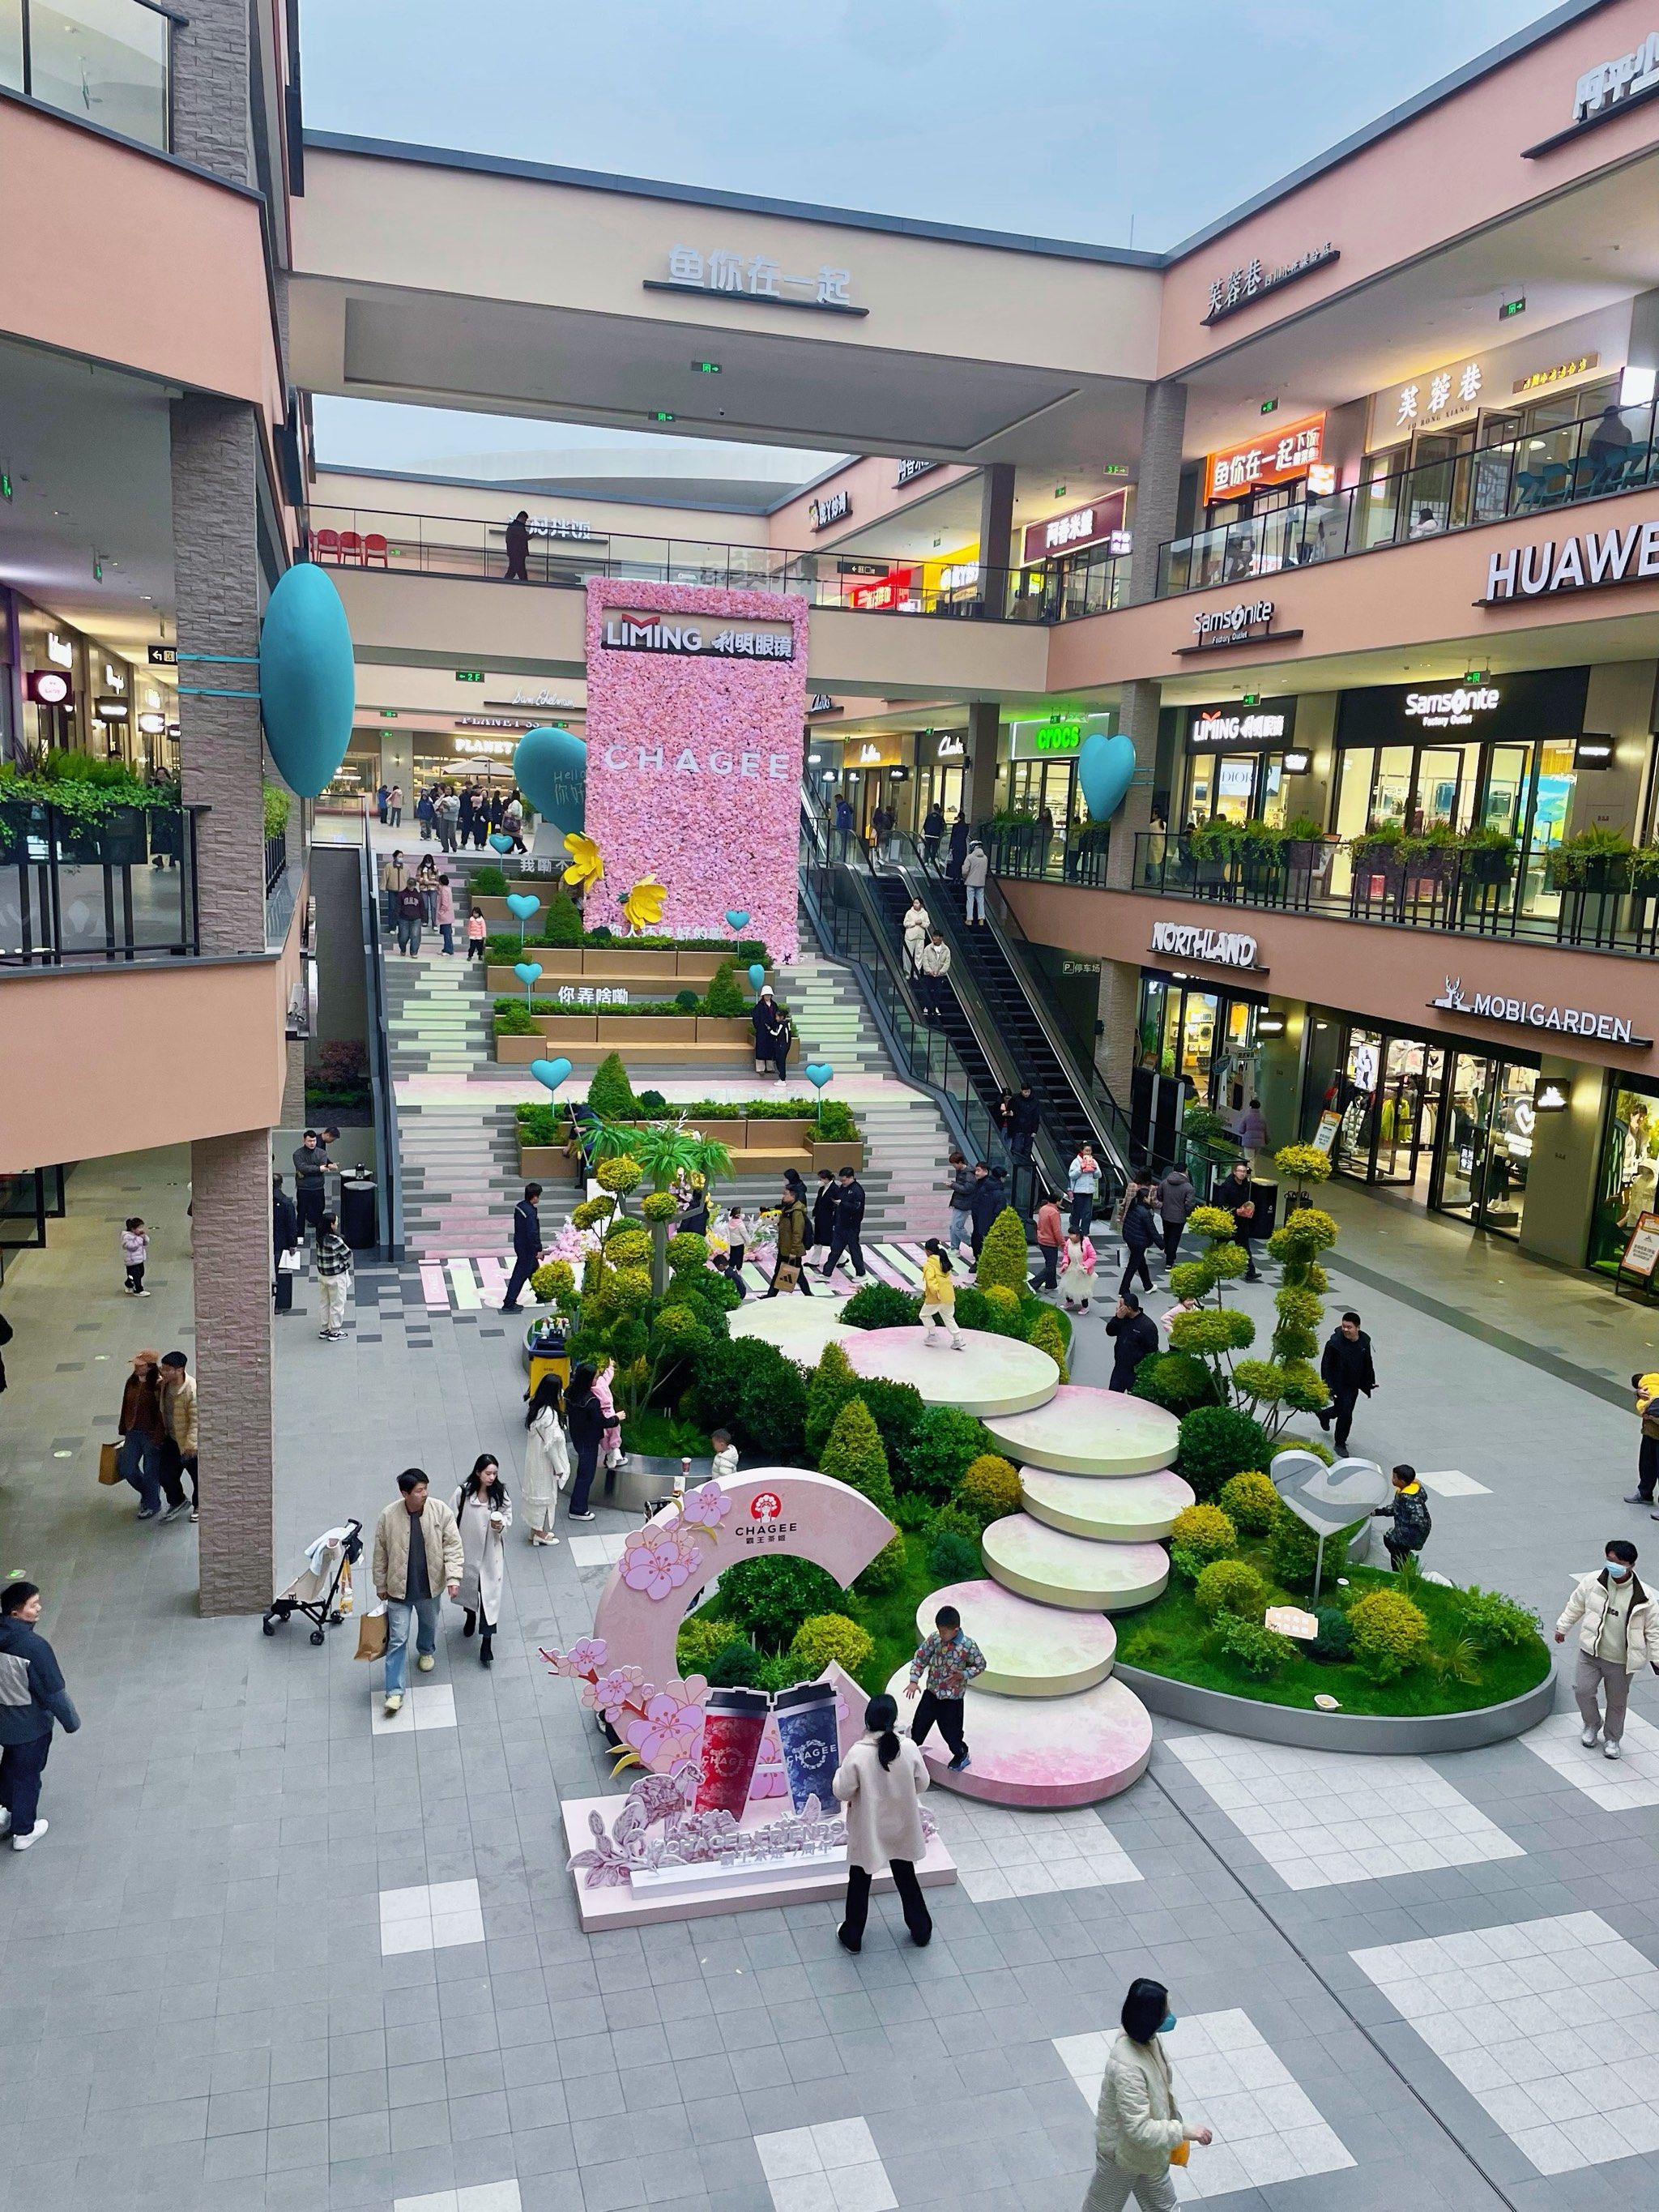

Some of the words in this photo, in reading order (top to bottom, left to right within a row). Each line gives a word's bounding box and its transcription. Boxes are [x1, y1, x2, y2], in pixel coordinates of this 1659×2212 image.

[668, 244, 850, 305] 鱼你在一起
[1206, 258, 1264, 320] 芙蓉巷
[1396, 363, 1482, 426] 芙蓉巷
[1213, 438, 1294, 492] 鱼你在一起
[1192, 600, 1273, 634] Samsonite
[608, 616, 702, 651] LIMING
[711, 629, 792, 657] 利明眼镜
[1212, 635, 1230, 645] Factory
[1232, 630, 1247, 640] Outlet
[467, 673, 480, 681] 2F
[1405, 687, 1499, 715] Samsonite
[1038, 725, 1080, 749] crocs
[1192, 712, 1240, 741] LIMING
[454, 738, 514, 754] PLANET
[604, 745, 791, 779] CHAGEE
[554, 770, 586, 783] Hello
[554, 783, 586, 805] 你好
[1151, 922, 1256, 967] NORTHLAND
[1075, 963, 1100, 973] 停车场
[558, 986, 629, 1006] 你弄啥嘞
[1473, 993, 1632, 1043] MOBIGARDEN
[736, 1523, 797, 1535] CHAGEE
[746, 1535, 786, 1544] 霸王茶姬
[702, 1755, 754, 1767] CHAGEE
[786, 1744, 837, 1764] CHAGEE
[666, 1833, 752, 1854] CHAGEE
[754, 1819, 845, 1845] FRIENDS
